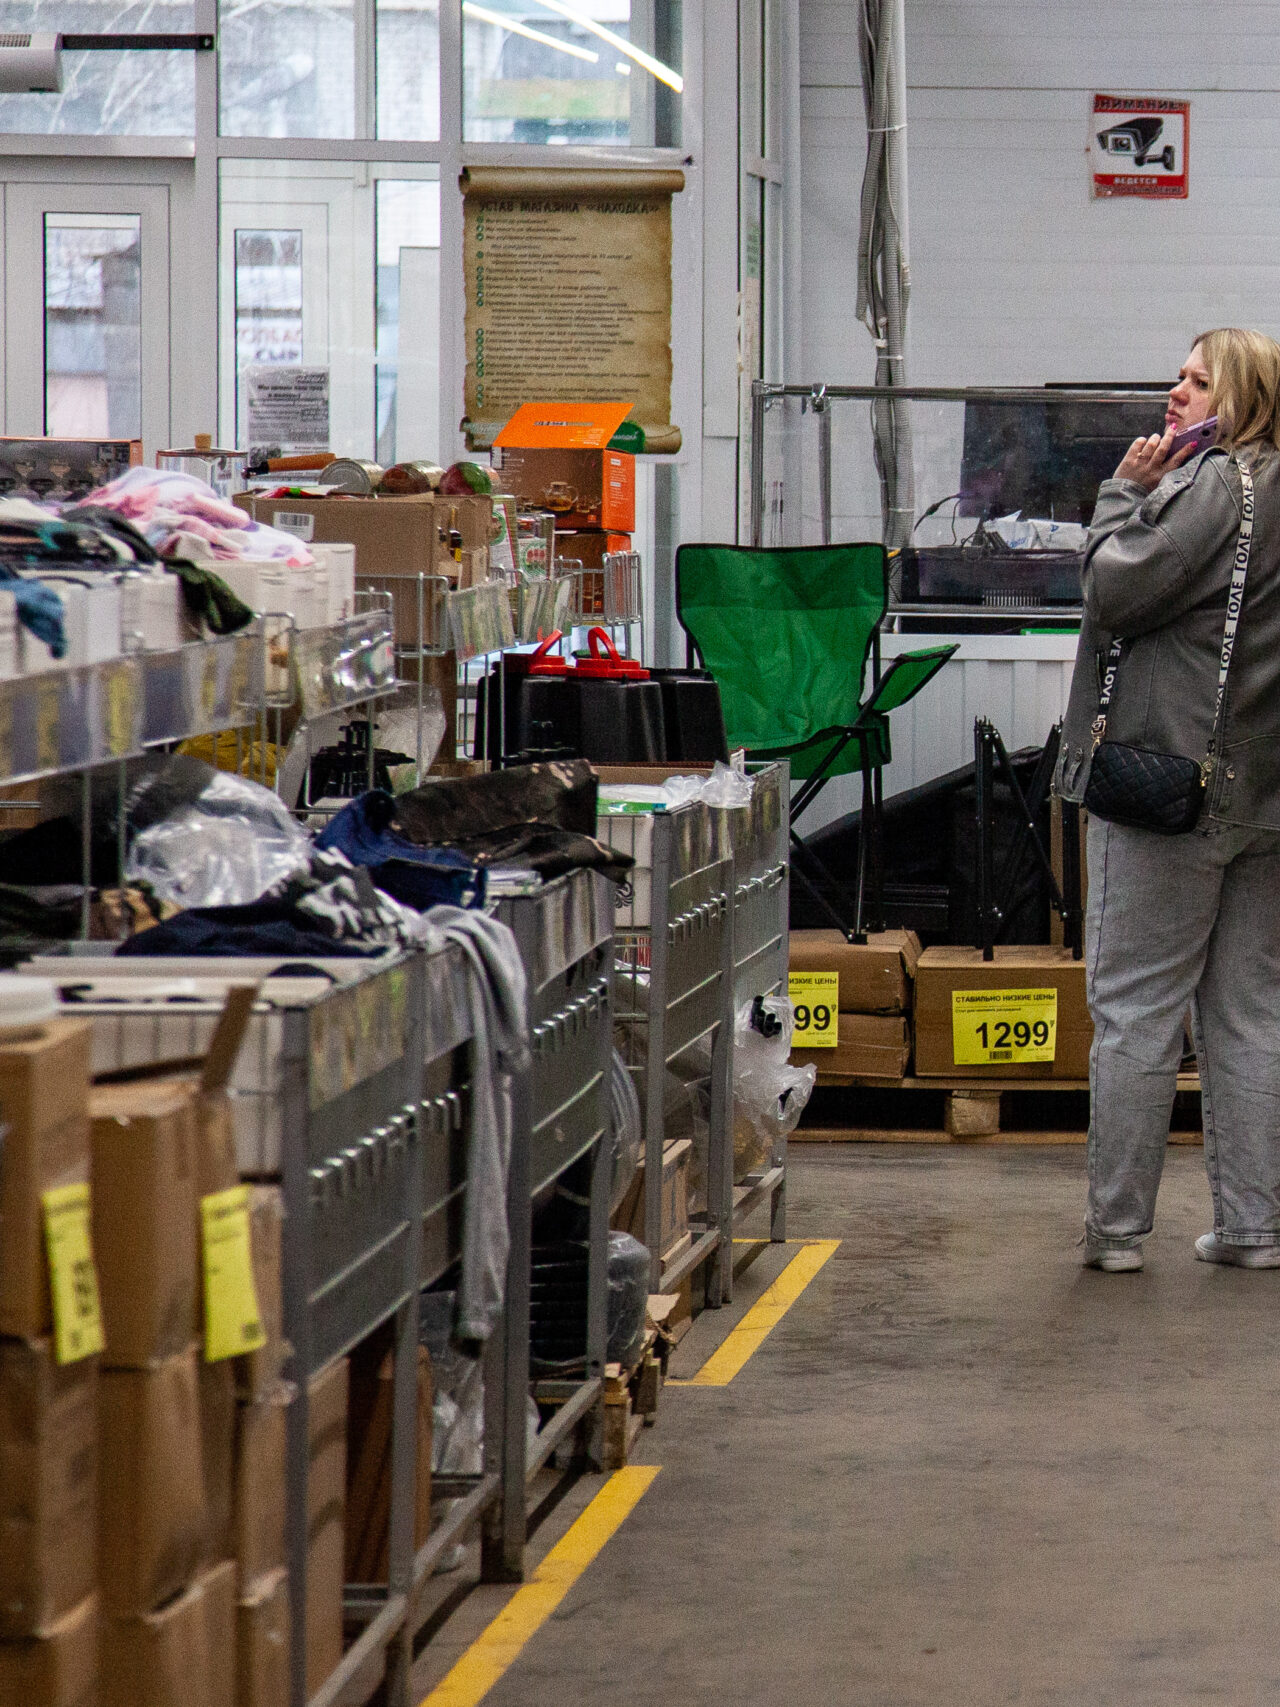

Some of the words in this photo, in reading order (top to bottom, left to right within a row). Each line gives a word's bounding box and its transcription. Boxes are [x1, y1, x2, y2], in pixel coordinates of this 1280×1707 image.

[479, 201, 514, 213] УСТАВ
[520, 202, 579, 213] МАГАЗИНА
[1100, 666, 1116, 705] LOVE
[814, 977, 837, 985] ЦЕНЫ
[955, 995, 1001, 1004] СТАБИЛЬНО
[1033, 993, 1056, 1001] ЦЕНЫ
[793, 1004, 831, 1031] 99
[975, 1020, 1049, 1049] 1299
